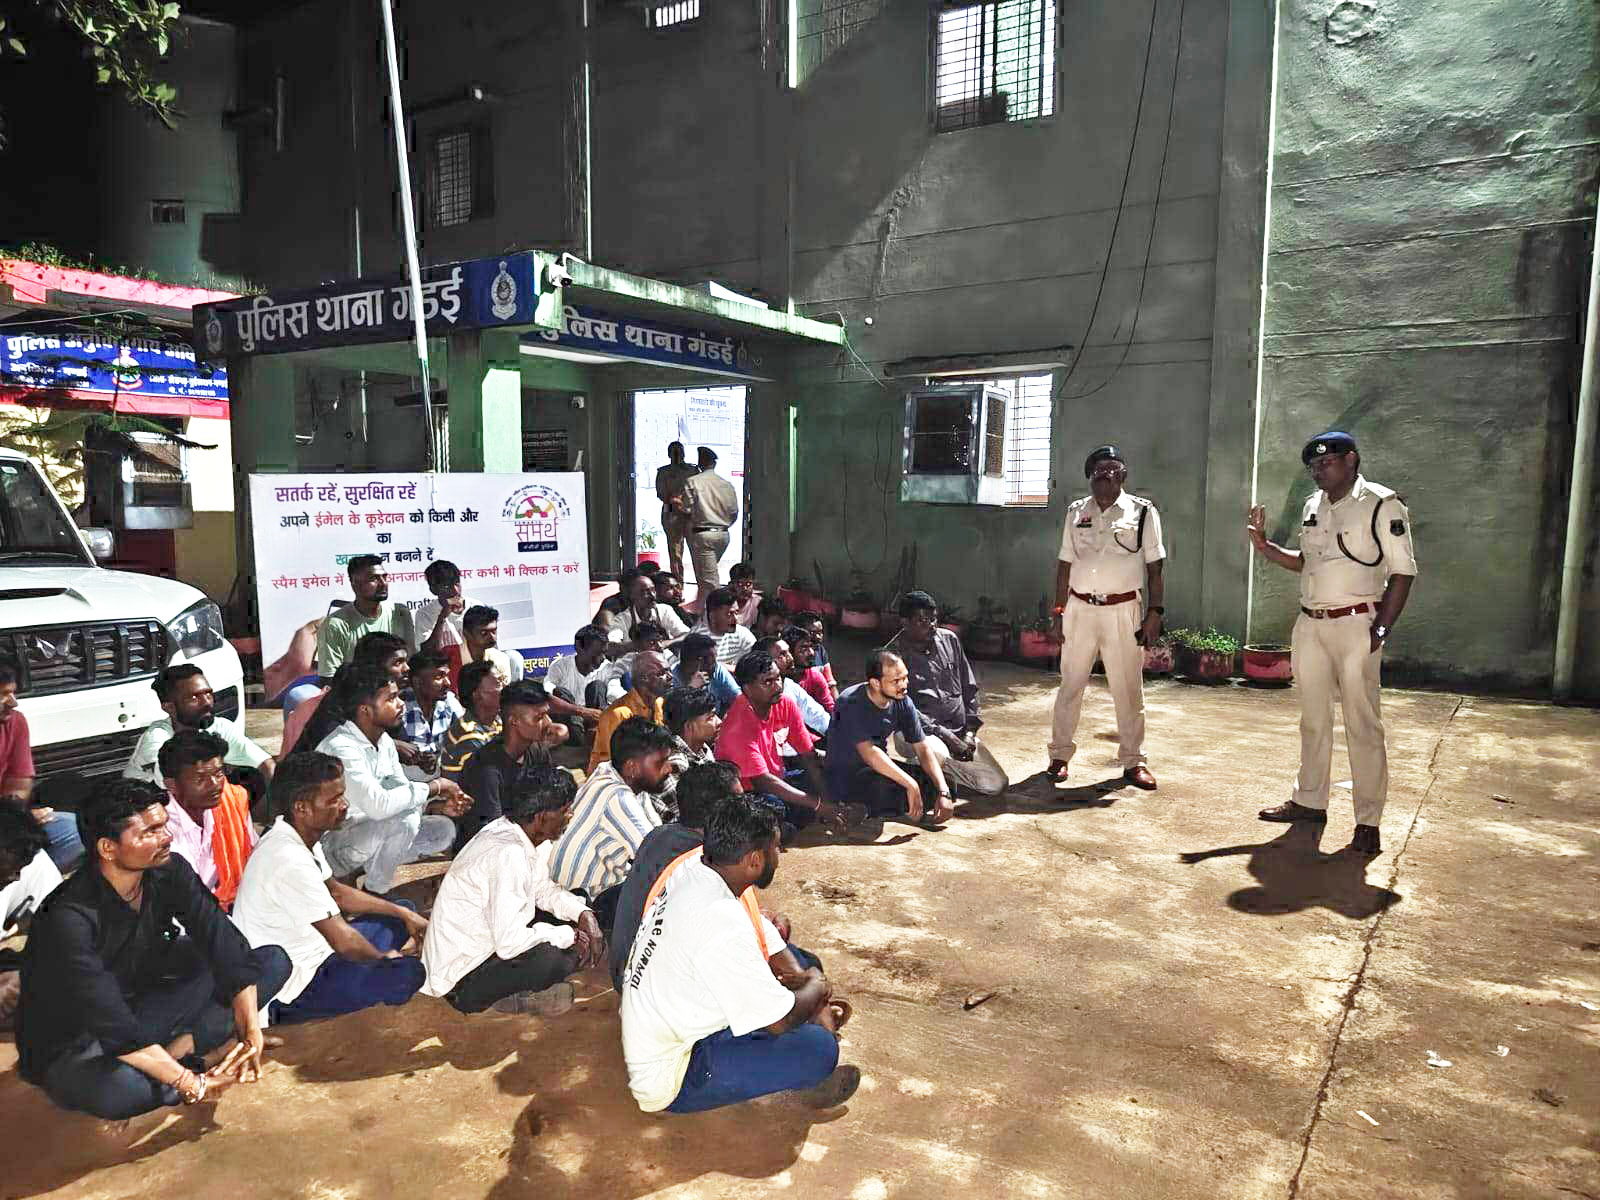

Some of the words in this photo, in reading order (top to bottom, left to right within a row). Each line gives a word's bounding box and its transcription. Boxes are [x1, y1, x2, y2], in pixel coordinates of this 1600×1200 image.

[236, 295, 309, 352] पुलिस
[316, 289, 384, 332] थाना
[392, 266, 464, 324] गडई
[540, 305, 619, 343] ुलिस
[624, 324, 684, 354] थाना
[688, 331, 735, 366] गंडई
[275, 483, 314, 502] सतर्क
[317, 483, 341, 503] रहें,
[344, 481, 394, 505] सुरक्षित
[397, 481, 417, 500] रहें
[280, 511, 310, 527] अपने
[314, 511, 344, 528] ईमेल
[348, 510, 360, 525] के
[365, 509, 405, 528] कूड़ेदान
[409, 508, 424, 524] को
[429, 508, 455, 523] किसी
[460, 507, 479, 522] और
[377, 532, 392, 543] का
[395, 548, 422, 562] बनने
[426, 547, 436, 561] दें
[272, 576, 297, 589] स्पैम
[302, 574, 330, 589] इमेल
[334, 573, 345, 586] में
[477, 565, 500, 578] कभी
[503, 564, 515, 577] भी
[519, 564, 548, 576] क्लिक
[552, 565, 560, 574] न
[563, 561, 580, 574] करें
[407, 598, 433, 610] Draft
[524, 656, 550, 673] सुरक्षा
